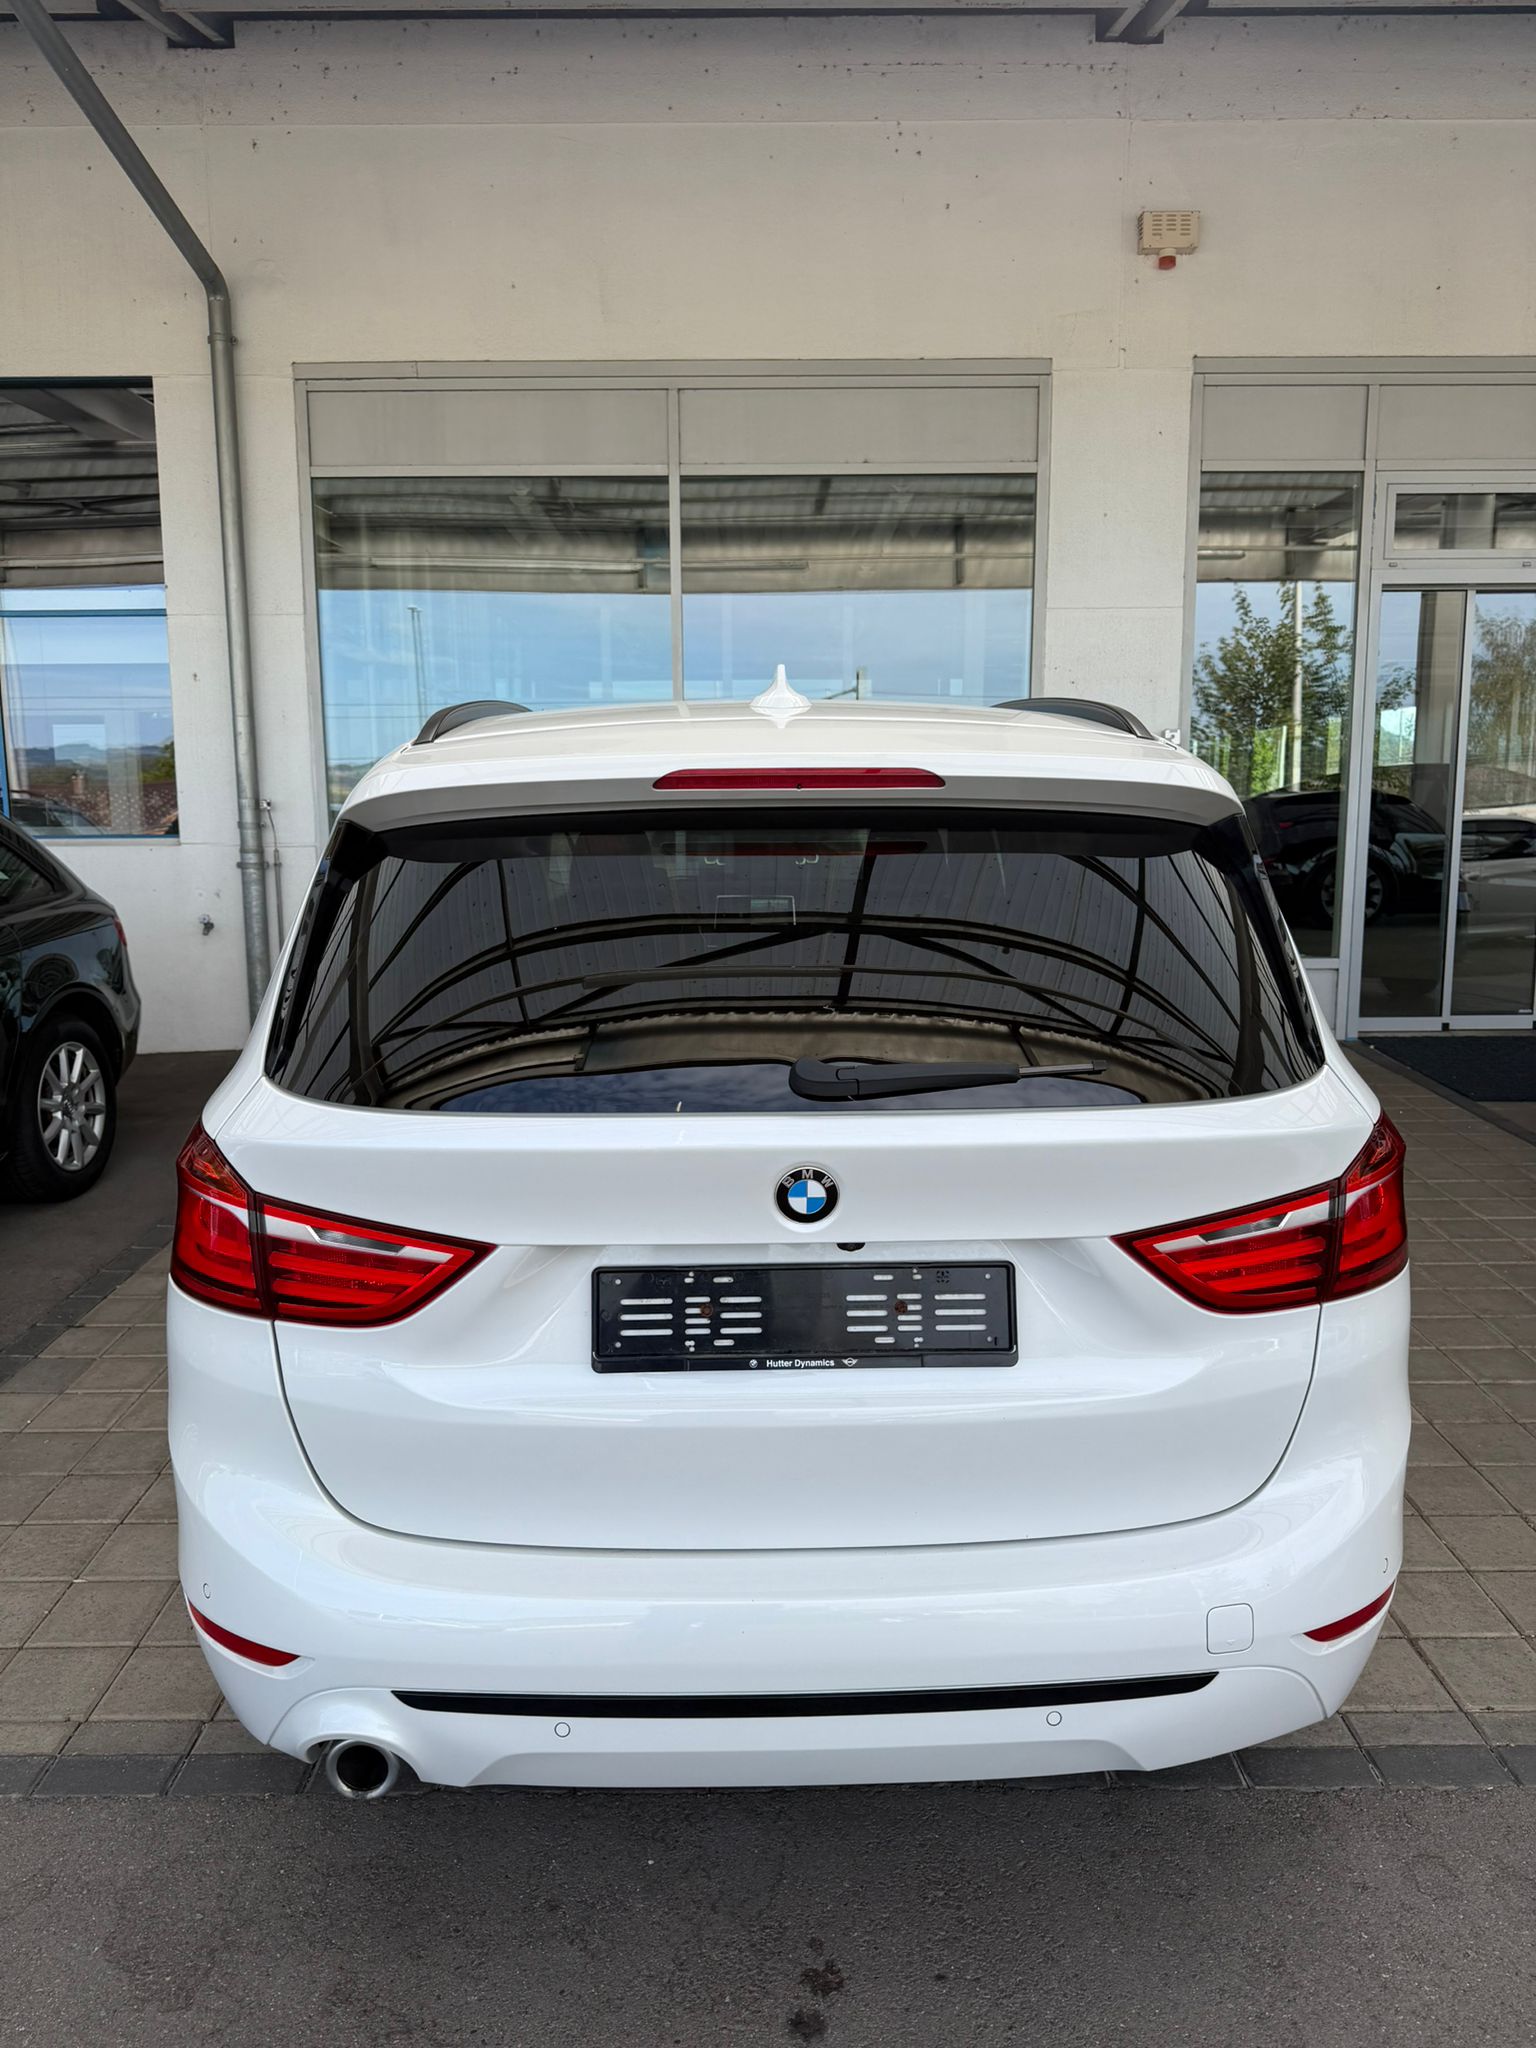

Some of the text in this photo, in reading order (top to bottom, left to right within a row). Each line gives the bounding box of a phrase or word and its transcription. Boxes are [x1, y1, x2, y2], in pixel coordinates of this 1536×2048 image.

[781, 1169, 834, 1188] BMW
[766, 1358, 835, 1369] Hutter Dynamics
